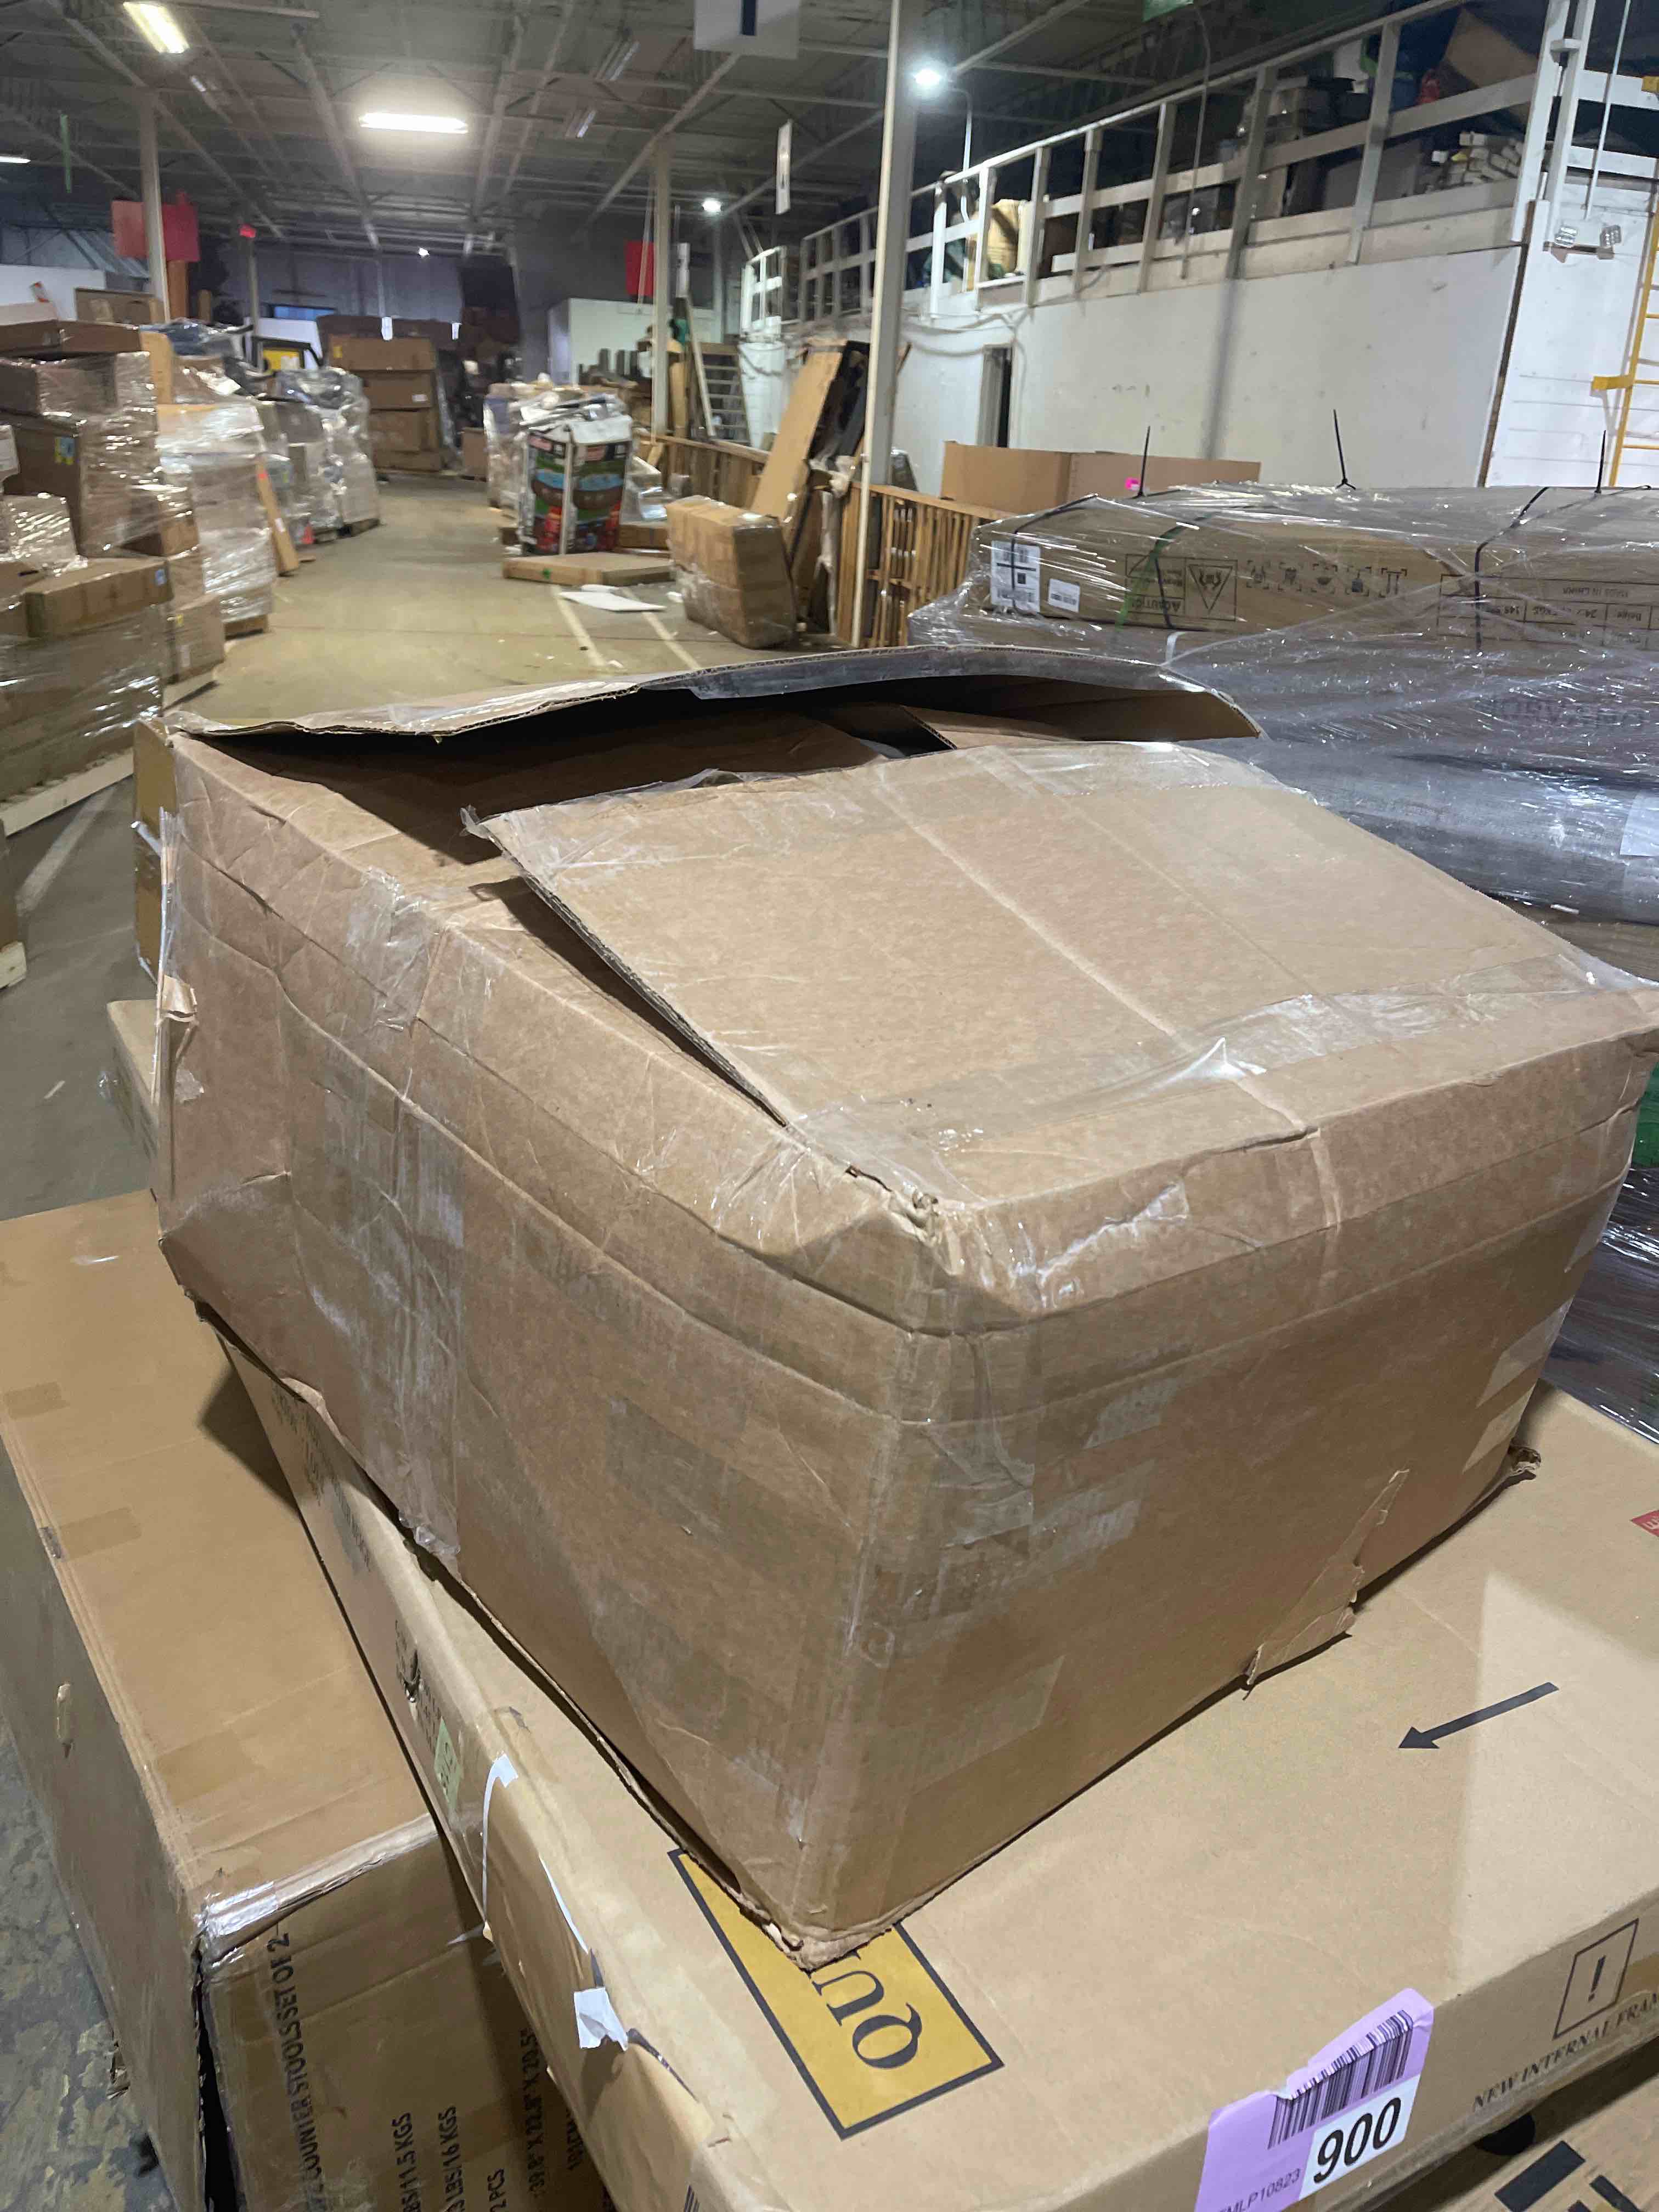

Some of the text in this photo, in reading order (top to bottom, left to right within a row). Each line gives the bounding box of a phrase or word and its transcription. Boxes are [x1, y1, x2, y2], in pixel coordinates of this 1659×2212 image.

[266, 1933, 290, 1952] 2
[270, 1955, 294, 1984] OF
[274, 1985, 300, 2021] SET
[811, 1949, 922, 2069] QU
[279, 2021, 310, 2097] STOOLS
[1474, 2072, 1519, 2112] NEW
[1521, 2021, 1612, 2083] INTERNAL
[392, 2112, 413, 2151] KGS
[438, 2106, 458, 2145] KGS
[1313, 2097, 1401, 2184] 900
[487, 2169, 506, 2202] PCS
